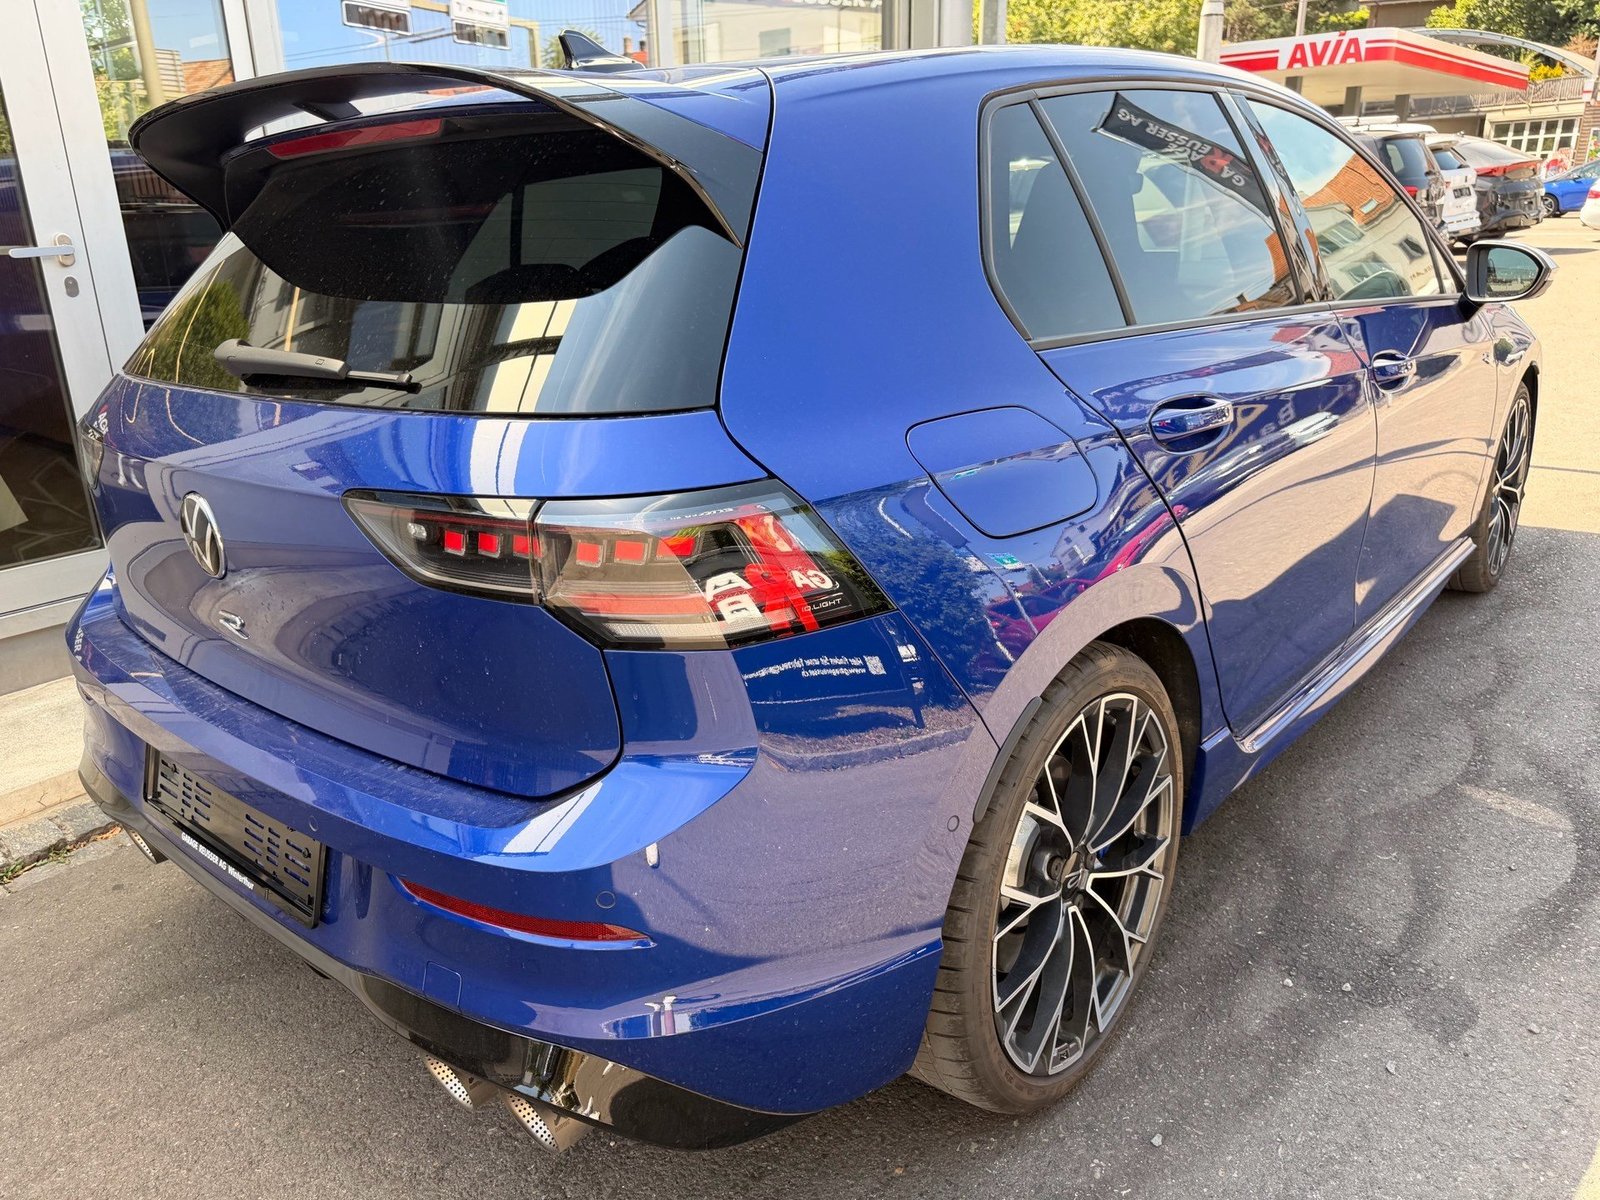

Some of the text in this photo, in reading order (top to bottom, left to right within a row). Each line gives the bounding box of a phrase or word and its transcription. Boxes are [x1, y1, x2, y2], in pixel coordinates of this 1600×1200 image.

[1287, 31, 1363, 69] AVIA
[1117, 107, 1144, 127] AG
[181, 832, 255, 890] GARAGE REUSSER AG Winterthur
